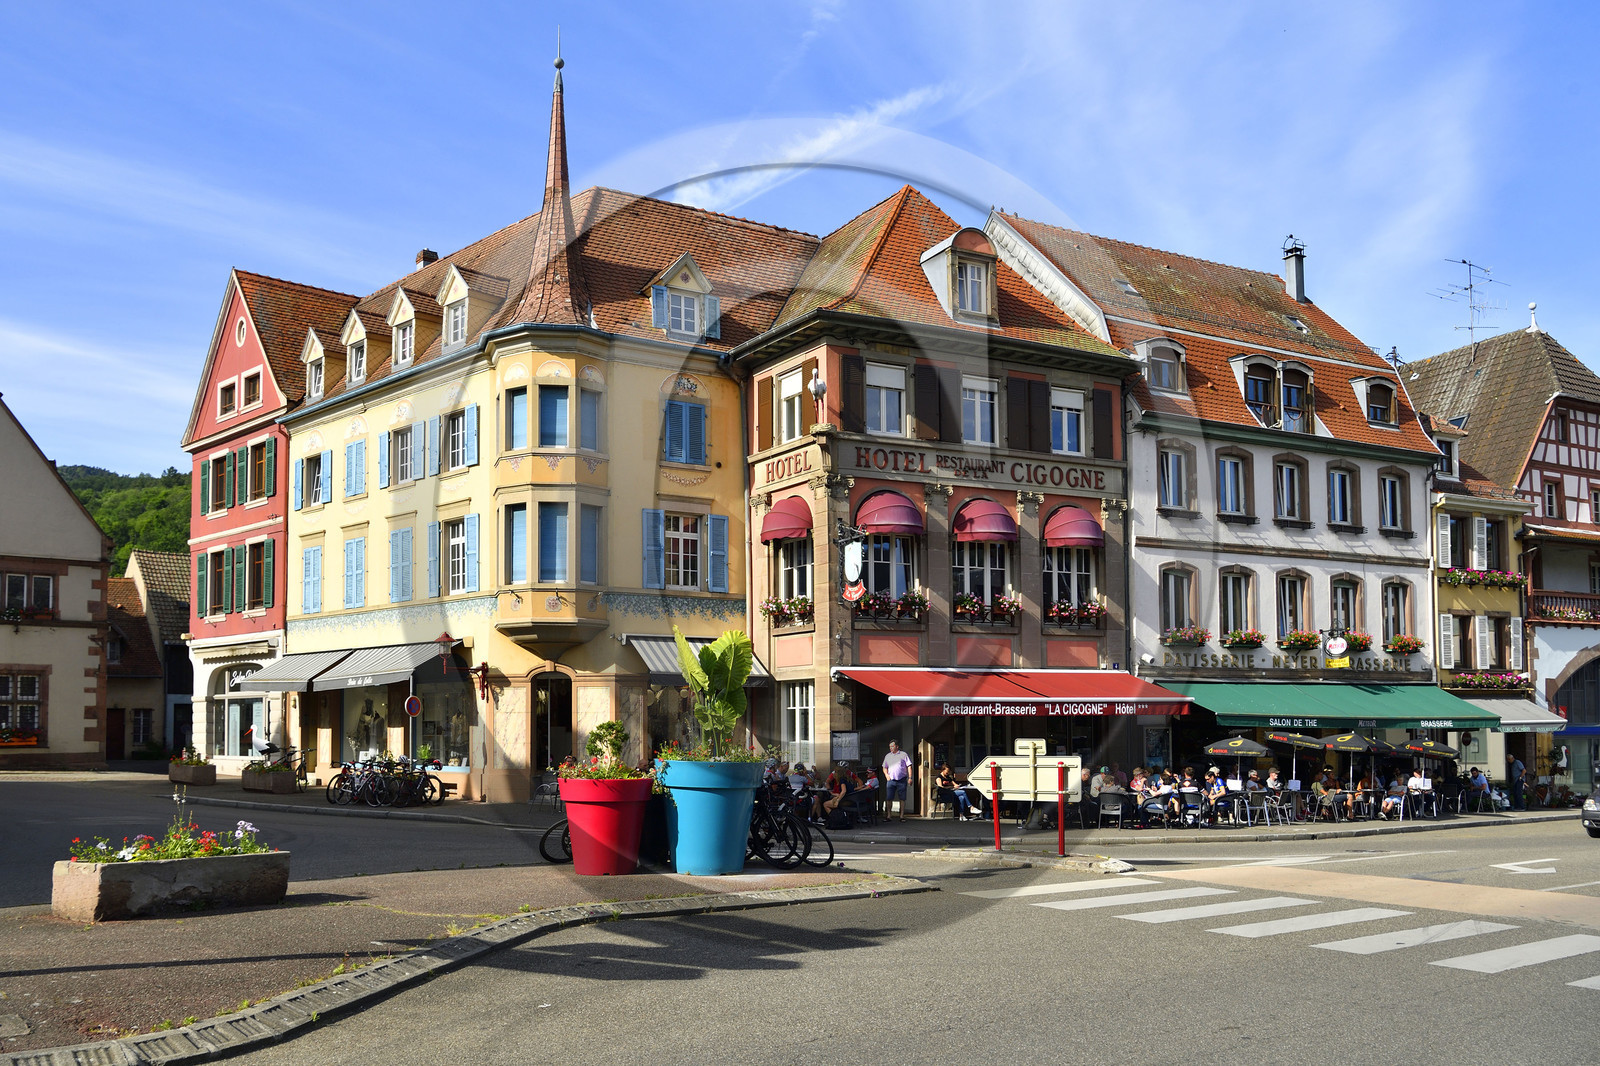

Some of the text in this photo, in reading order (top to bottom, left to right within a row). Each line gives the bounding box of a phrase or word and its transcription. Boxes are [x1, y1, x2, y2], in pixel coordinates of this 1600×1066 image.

[765, 450, 813, 484] HOTEL
[855, 446, 932, 474] HOTEL
[935, 454, 1006, 474] RESTAURANT
[953, 468, 989, 480] DE LA
[1010, 462, 1106, 490] CIGOGNE
[1163, 652, 1255, 668] PATISSERIE
[1272, 655, 1318, 669] MEYER
[1341, 657, 1412, 671] RASSERIE
[942, 702, 1136, 715] Restaurant-Brasserie "LA CIGOGNE" Hôtel
[1269, 718, 1318, 727] SALON DE THE
[1420, 719, 1454, 728] BRASSERIE
